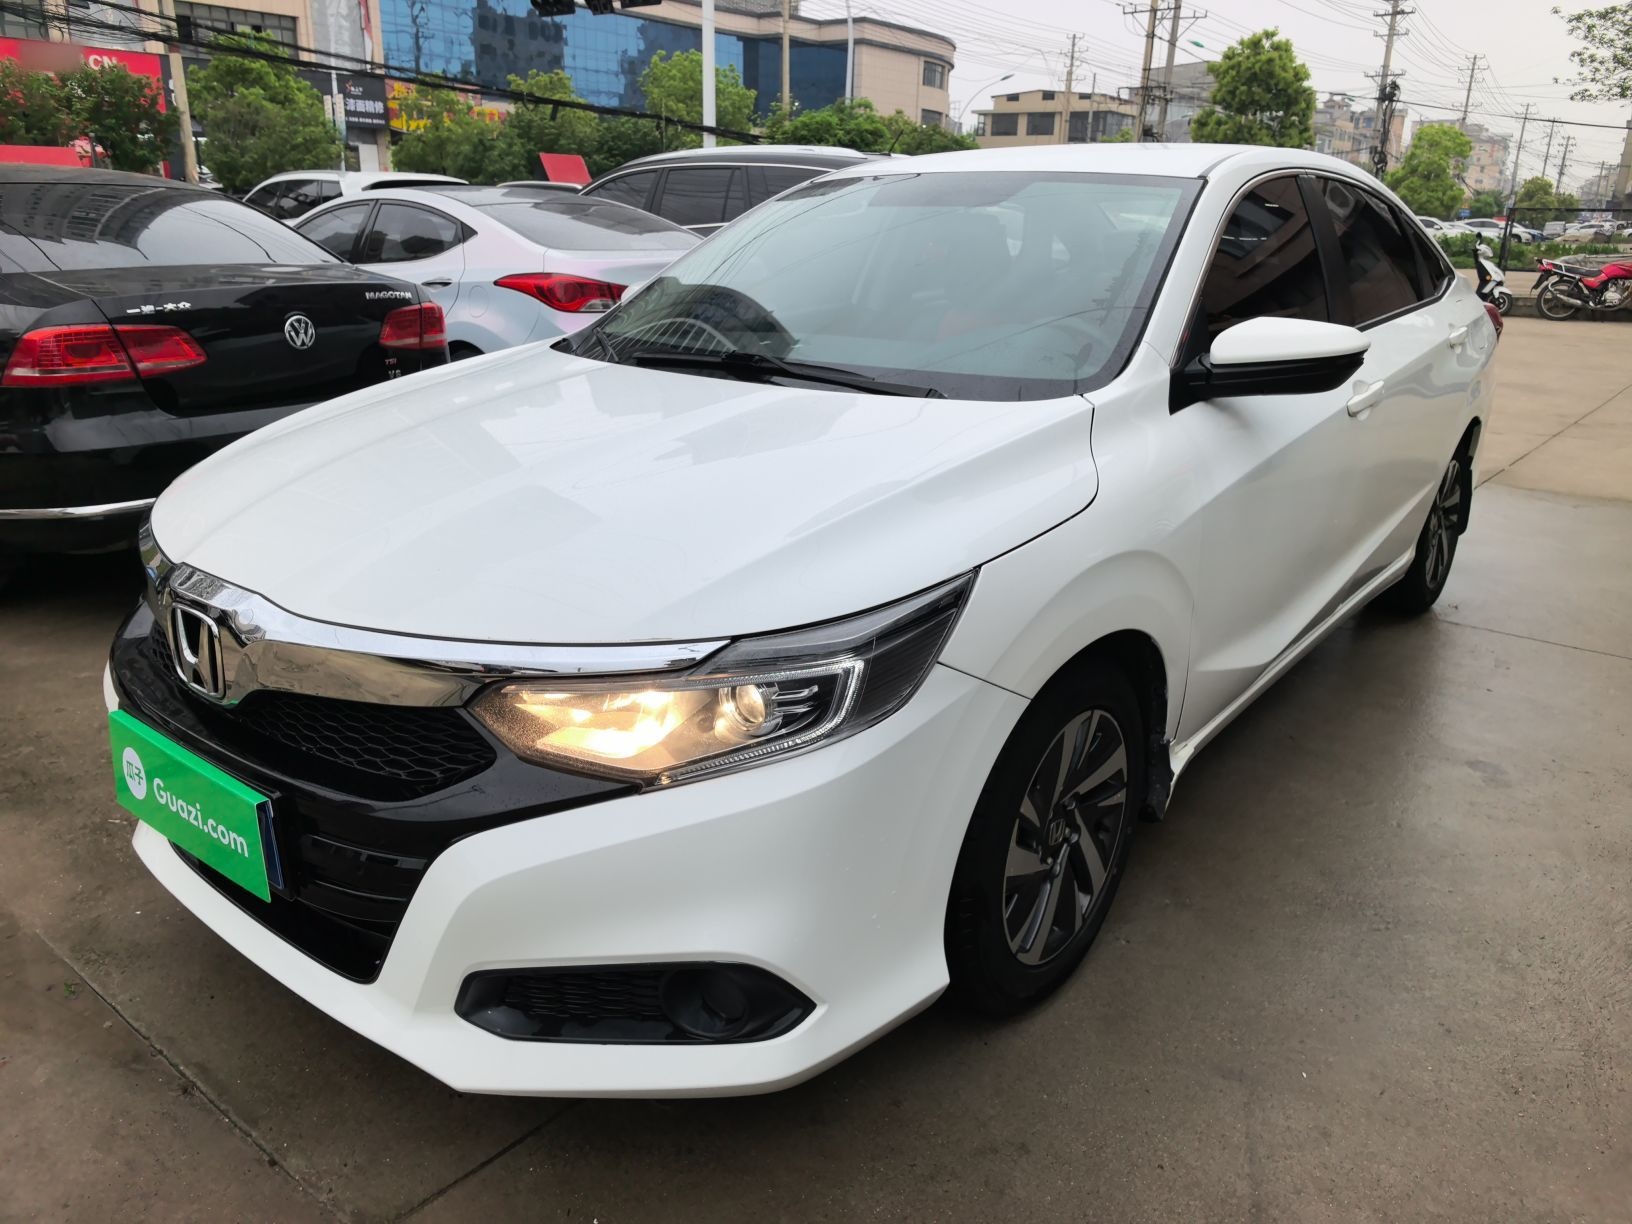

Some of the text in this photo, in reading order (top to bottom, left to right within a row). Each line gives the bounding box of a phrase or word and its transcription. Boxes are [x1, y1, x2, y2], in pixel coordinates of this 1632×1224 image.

[365, 291, 413, 300] MAGOTAN
[126, 760, 144, 787] 瓜子
[153, 777, 249, 858] Guazi.com
